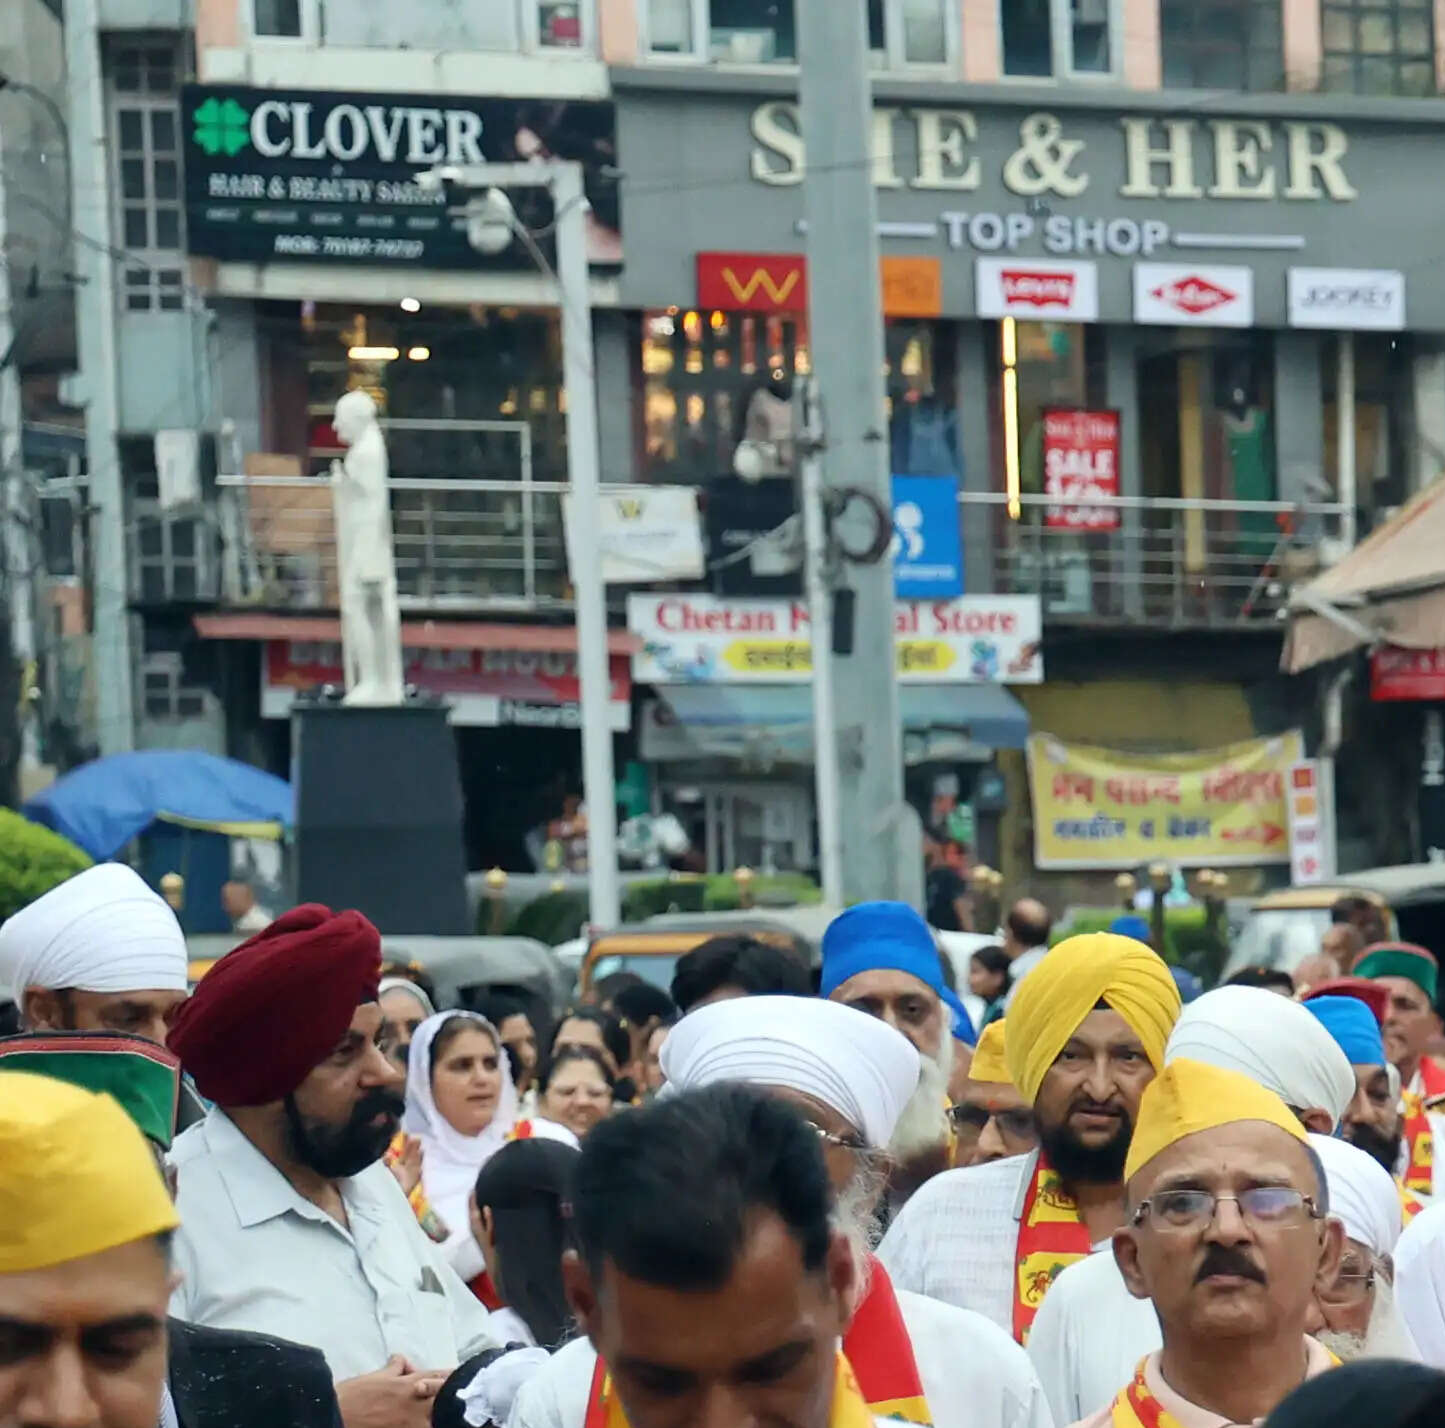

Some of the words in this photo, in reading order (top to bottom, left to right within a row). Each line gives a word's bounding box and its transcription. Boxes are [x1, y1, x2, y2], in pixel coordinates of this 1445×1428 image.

[250, 100, 485, 164] CLOVER
[1003, 113, 1089, 198] &
[1119, 118, 1358, 201] HER
[267, 175, 286, 199] &
[939, 211, 1031, 251] TOP
[1044, 215, 1170, 256] SHOP
[721, 267, 800, 304] W
[1046, 447, 1114, 478] SALE
[656, 600, 776, 633] Chetan
[931, 604, 1019, 636] Store
